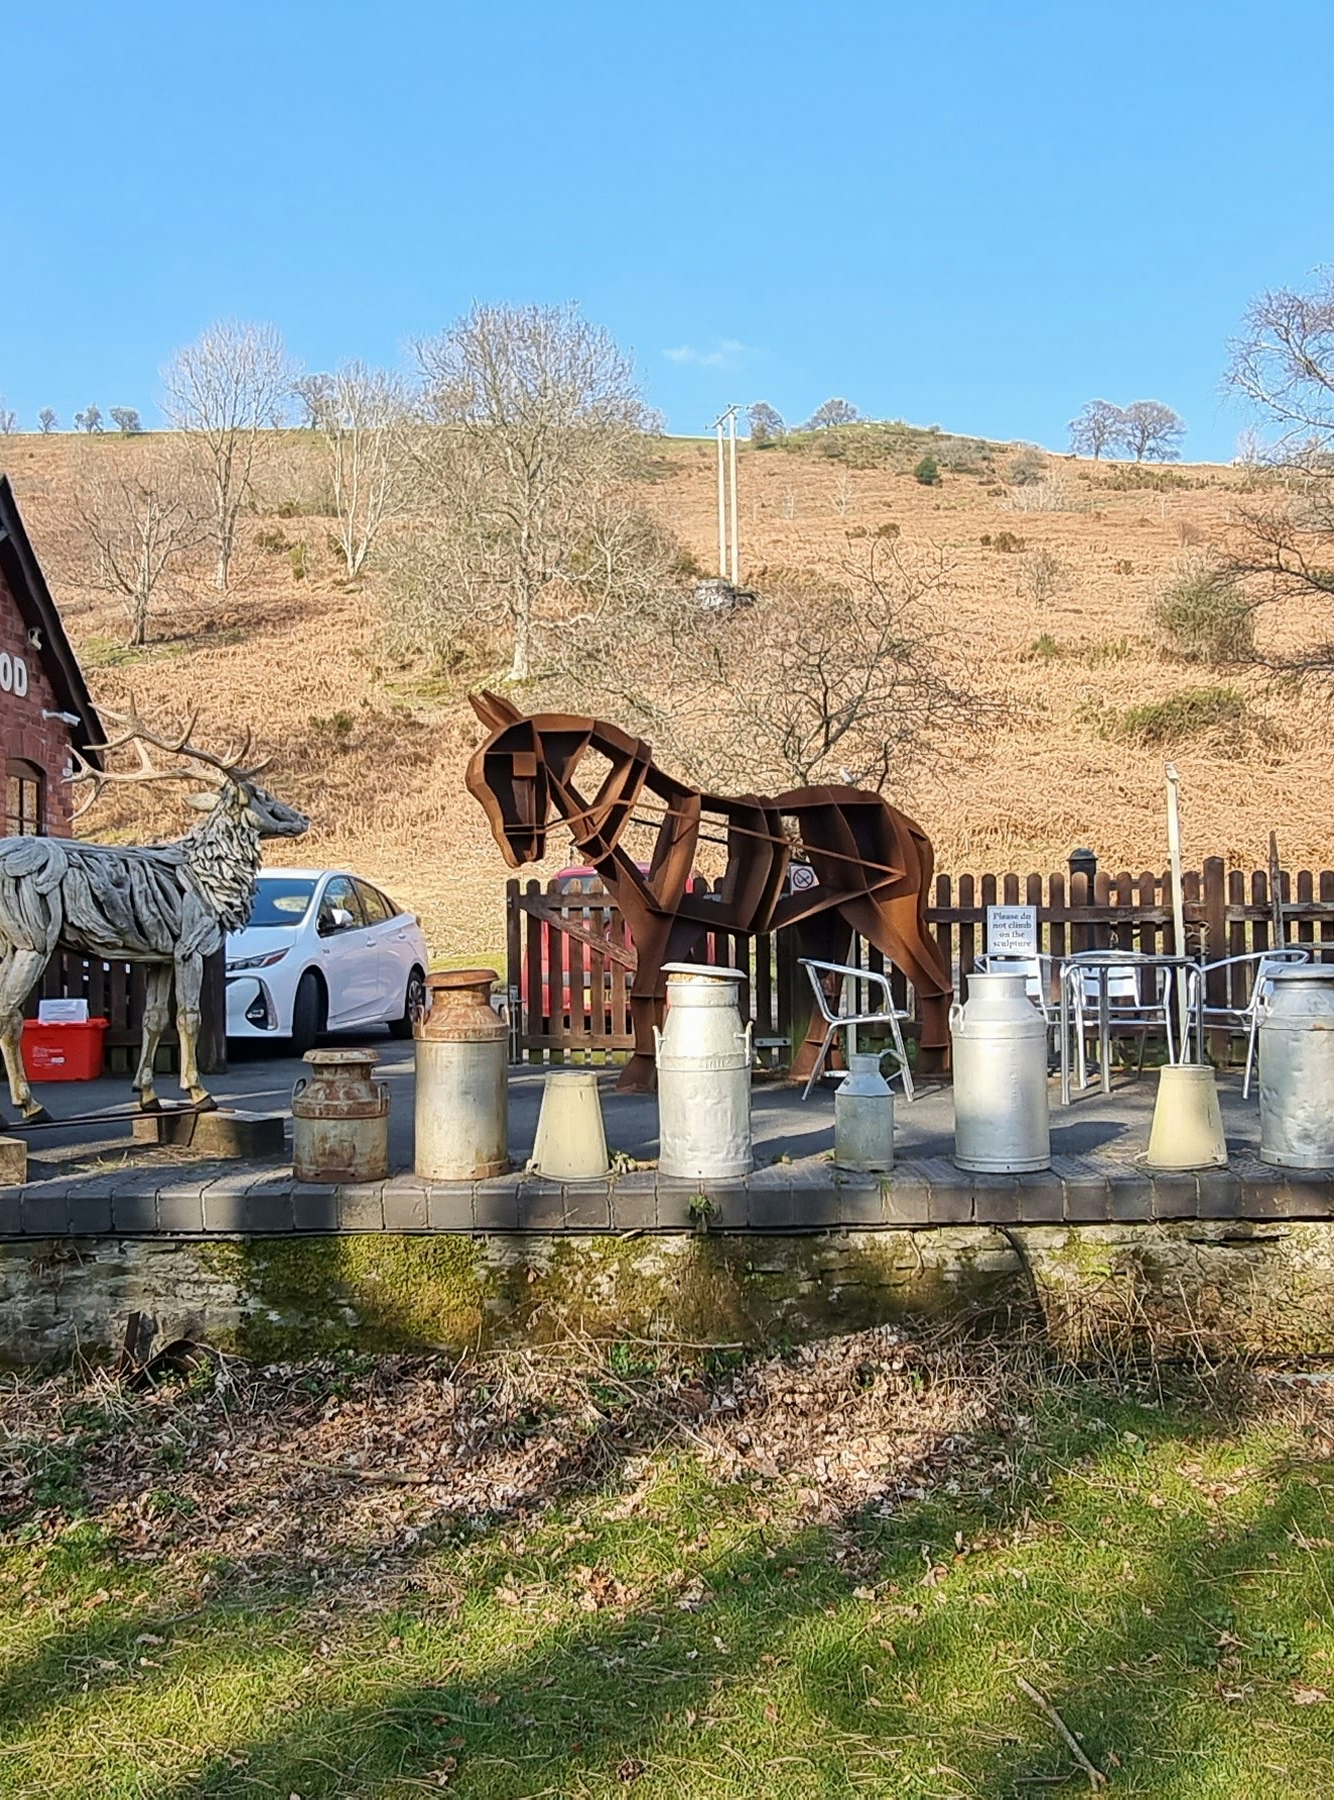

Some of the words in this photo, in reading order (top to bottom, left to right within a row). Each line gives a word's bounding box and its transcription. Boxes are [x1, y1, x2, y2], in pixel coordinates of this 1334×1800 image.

[993, 912, 1018, 920] Please
[1020, 912, 1031, 920] do
[1008, 921, 1031, 929] climb
[1012, 930, 1025, 938] the
[993, 939, 1031, 949] sculpture
